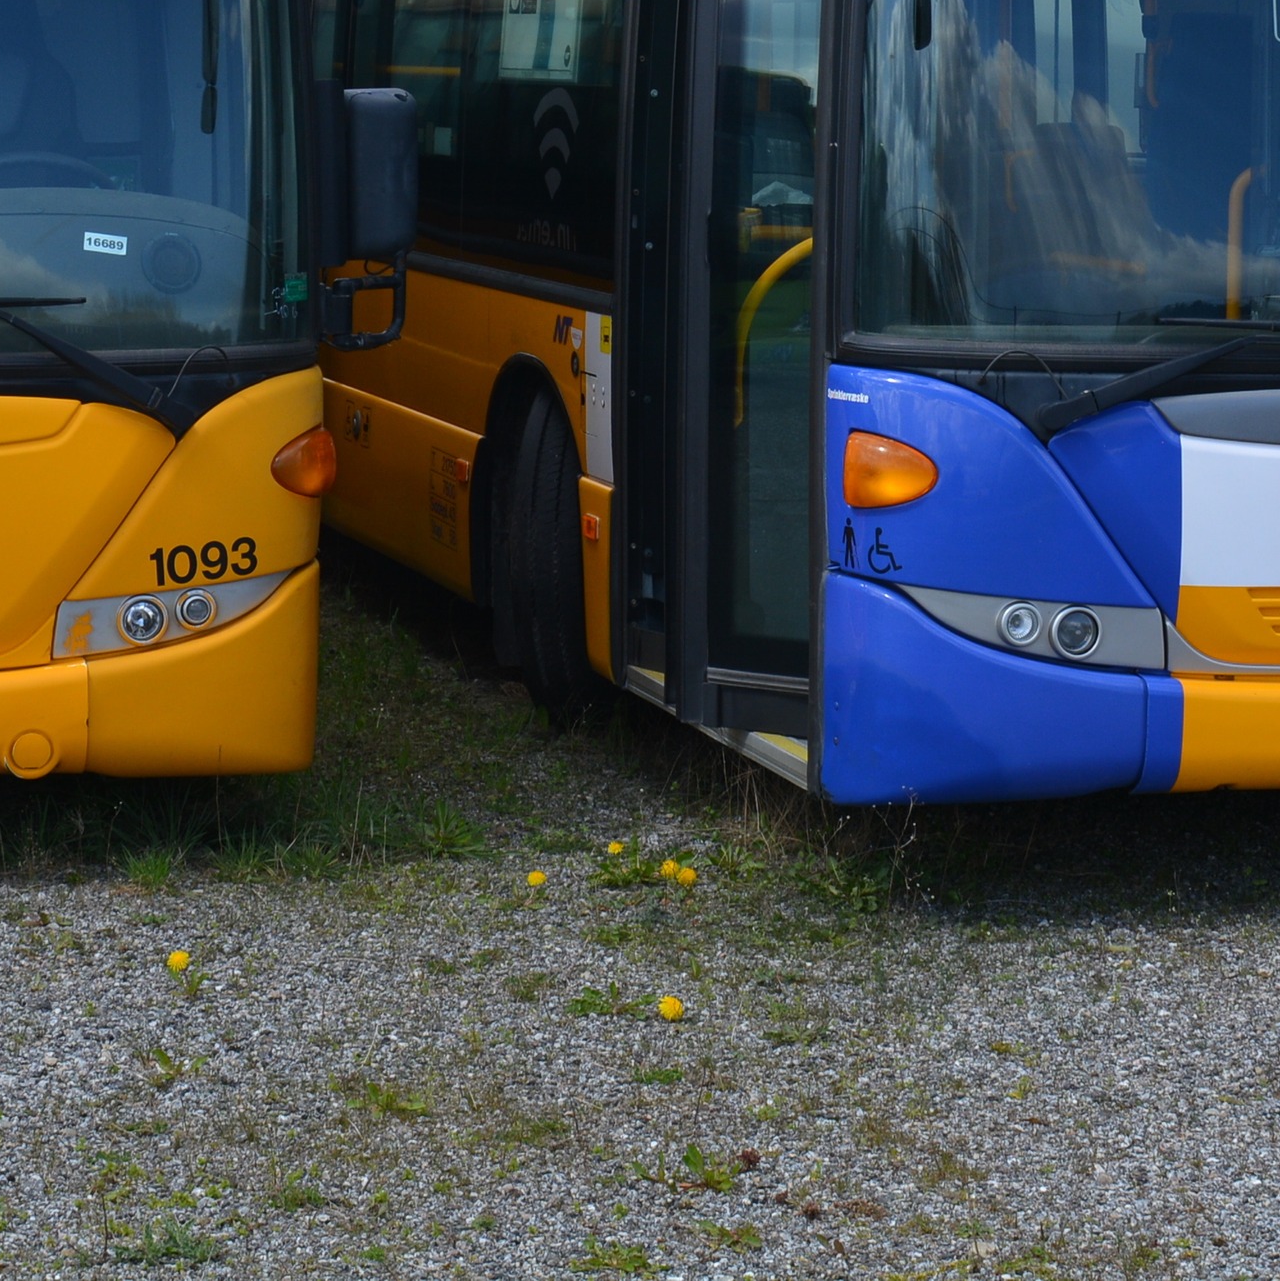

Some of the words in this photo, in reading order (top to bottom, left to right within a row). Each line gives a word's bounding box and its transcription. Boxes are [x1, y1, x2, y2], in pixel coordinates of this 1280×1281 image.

[86, 237, 124, 250] 16689
[553, 314, 573, 346] NT
[149, 537, 258, 587] 1093
